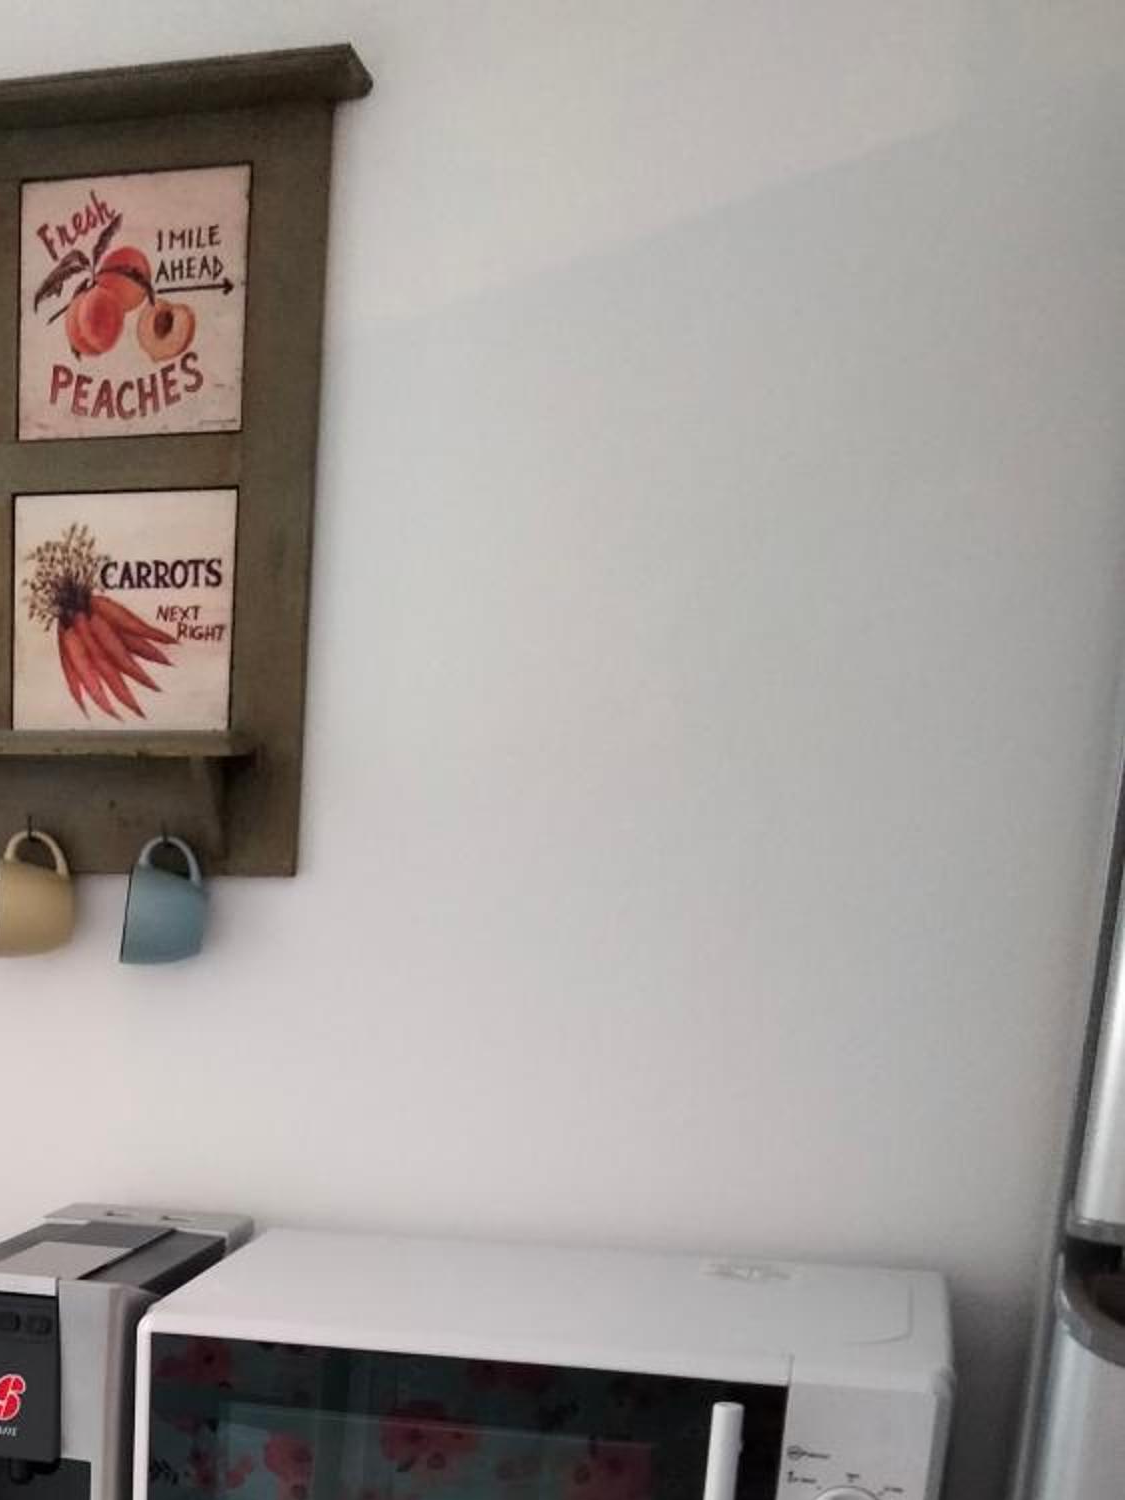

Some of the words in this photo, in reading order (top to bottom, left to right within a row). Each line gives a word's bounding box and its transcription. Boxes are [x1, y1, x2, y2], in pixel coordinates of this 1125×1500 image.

[36, 188, 117, 262] Fresh
[168, 224, 222, 250] MILE
[155, 255, 225, 283] AHEAD
[48, 351, 205, 420] PEACHES
[100, 558, 223, 590] CARROTS
[156, 604, 201, 622] NEXT
[176, 624, 228, 643] RIGHT
